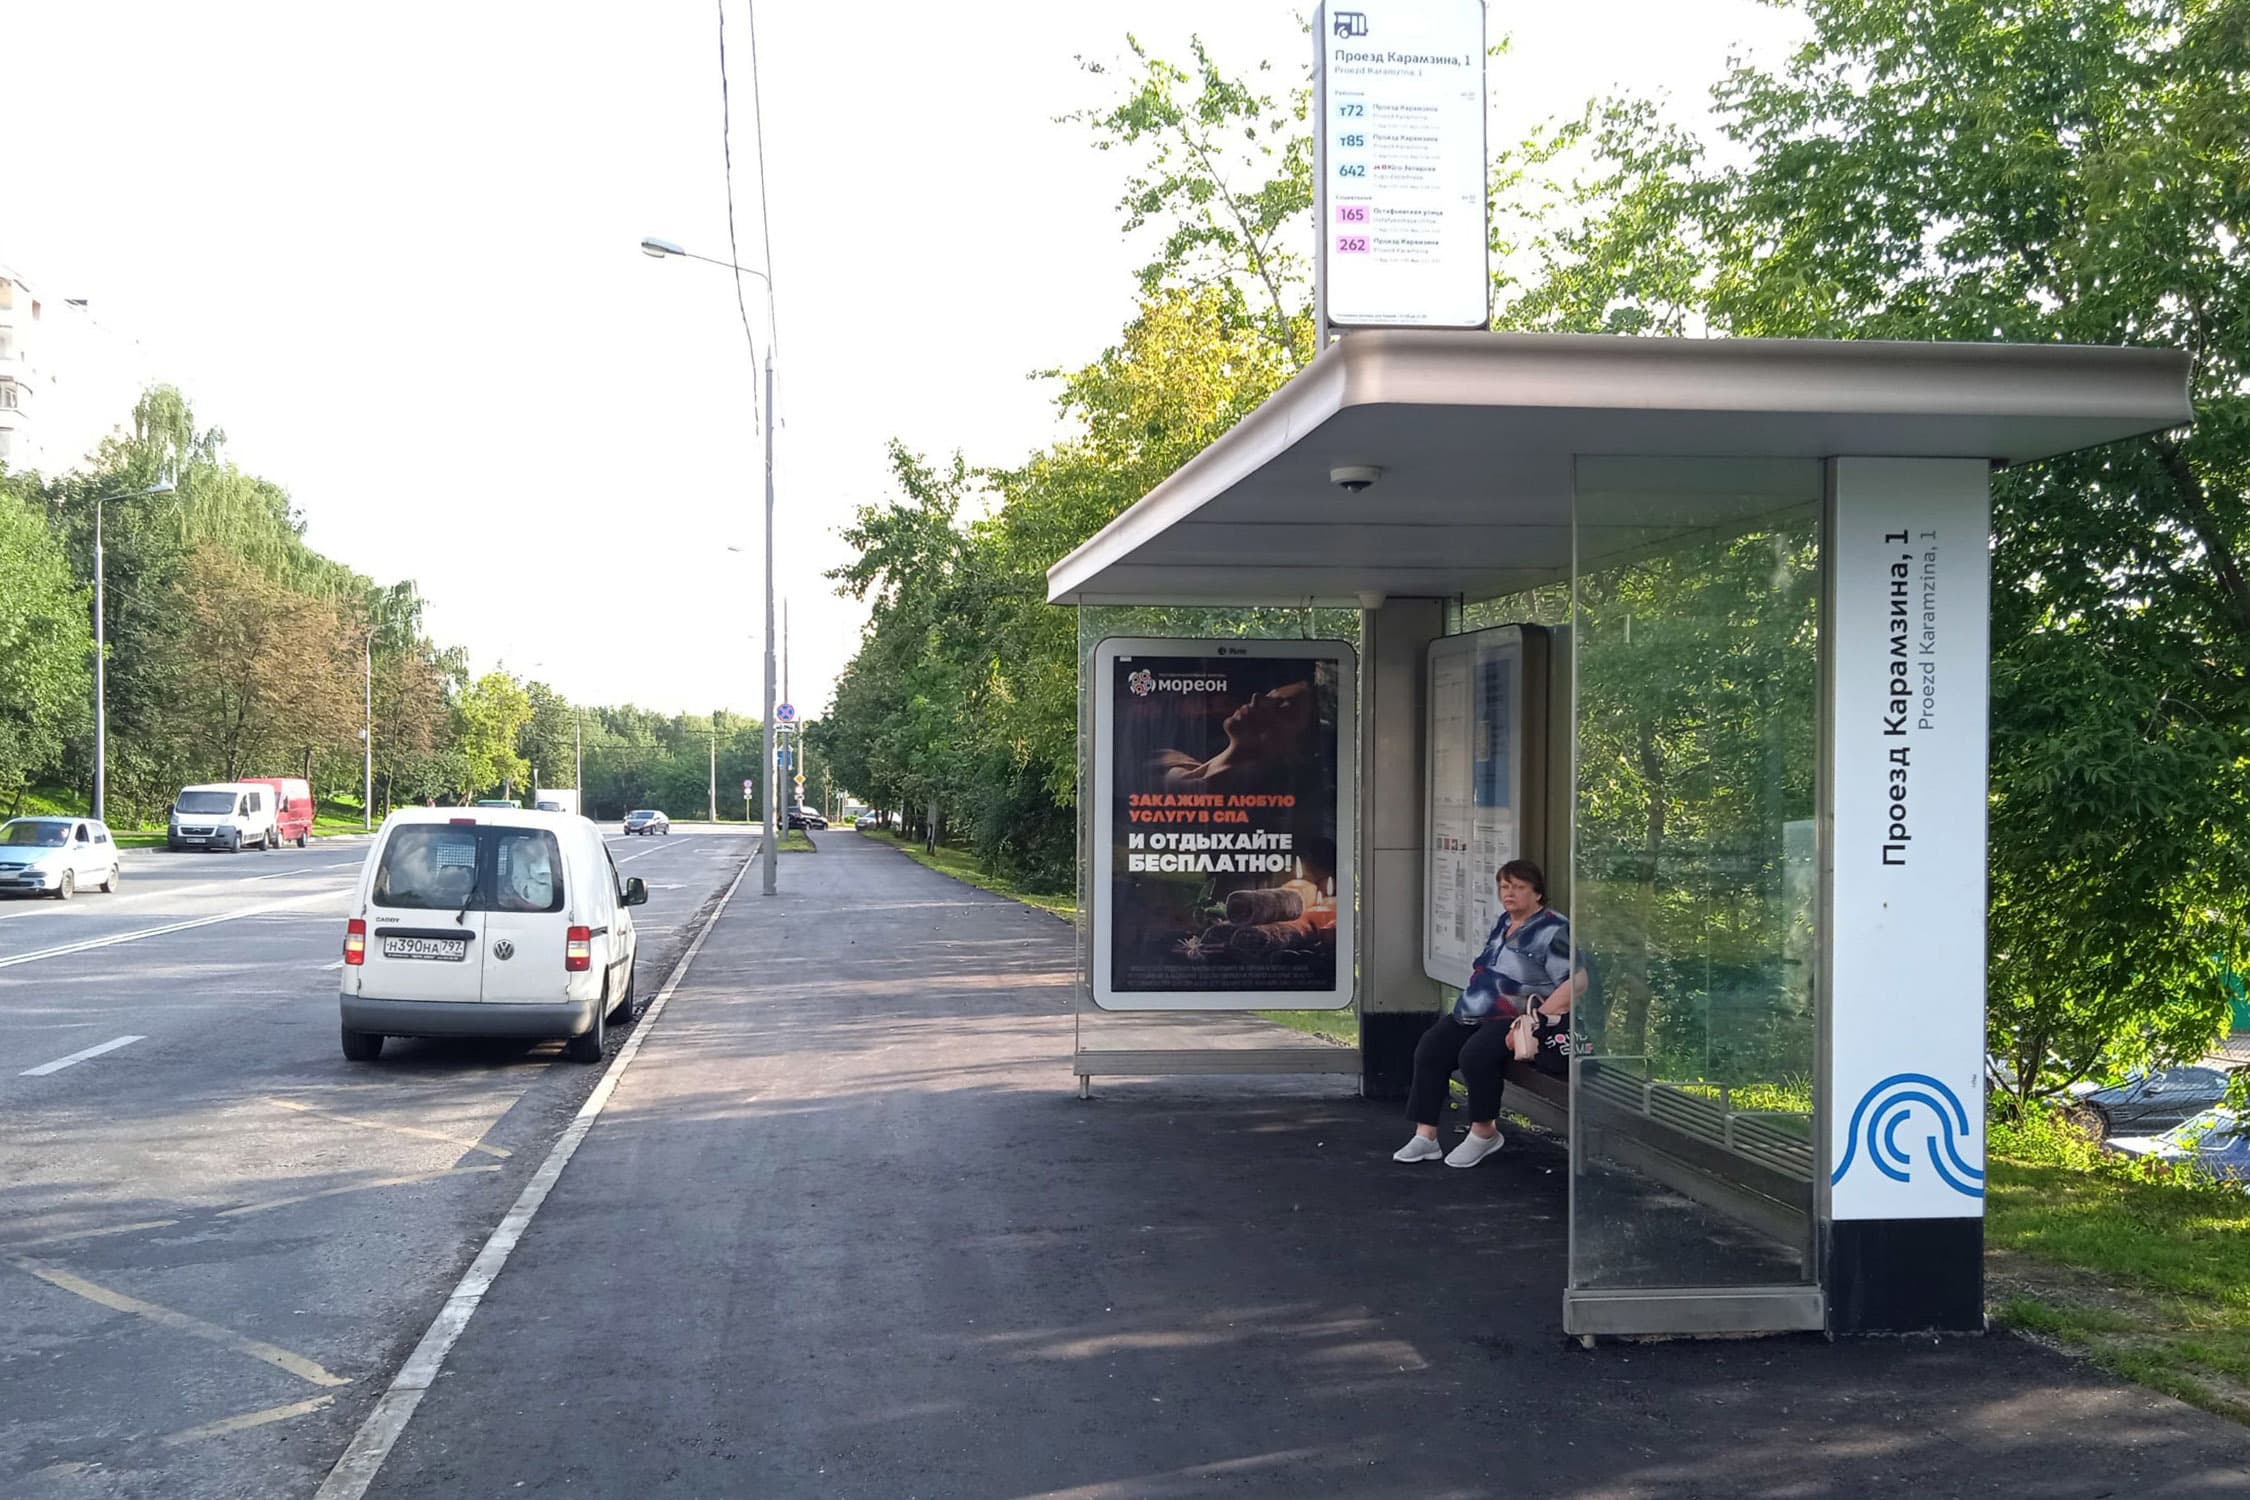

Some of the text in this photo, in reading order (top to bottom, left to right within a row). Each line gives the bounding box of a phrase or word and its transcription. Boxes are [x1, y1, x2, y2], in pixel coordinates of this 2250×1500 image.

[1335, 50, 1471, 67] Проезд Карамзина, 1
[1339, 165, 1365, 177] 642
[1341, 208, 1364, 221] 165
[1339, 239, 1366, 251] 262
[1918, 530, 1938, 730] Proezd Karamzina, 1
[1882, 529, 1913, 865] Проезд Карамзина, 1
[1128, 793, 1296, 808] ЗАКАЖИТЕ ЛЮБУЮ
[1129, 810, 1249, 823] УСЛУГУ В СПА
[1128, 829, 1293, 852] И ОТДЫХАЙТЕ
[1128, 853, 1292, 873] БЕСПЛАТНО!
